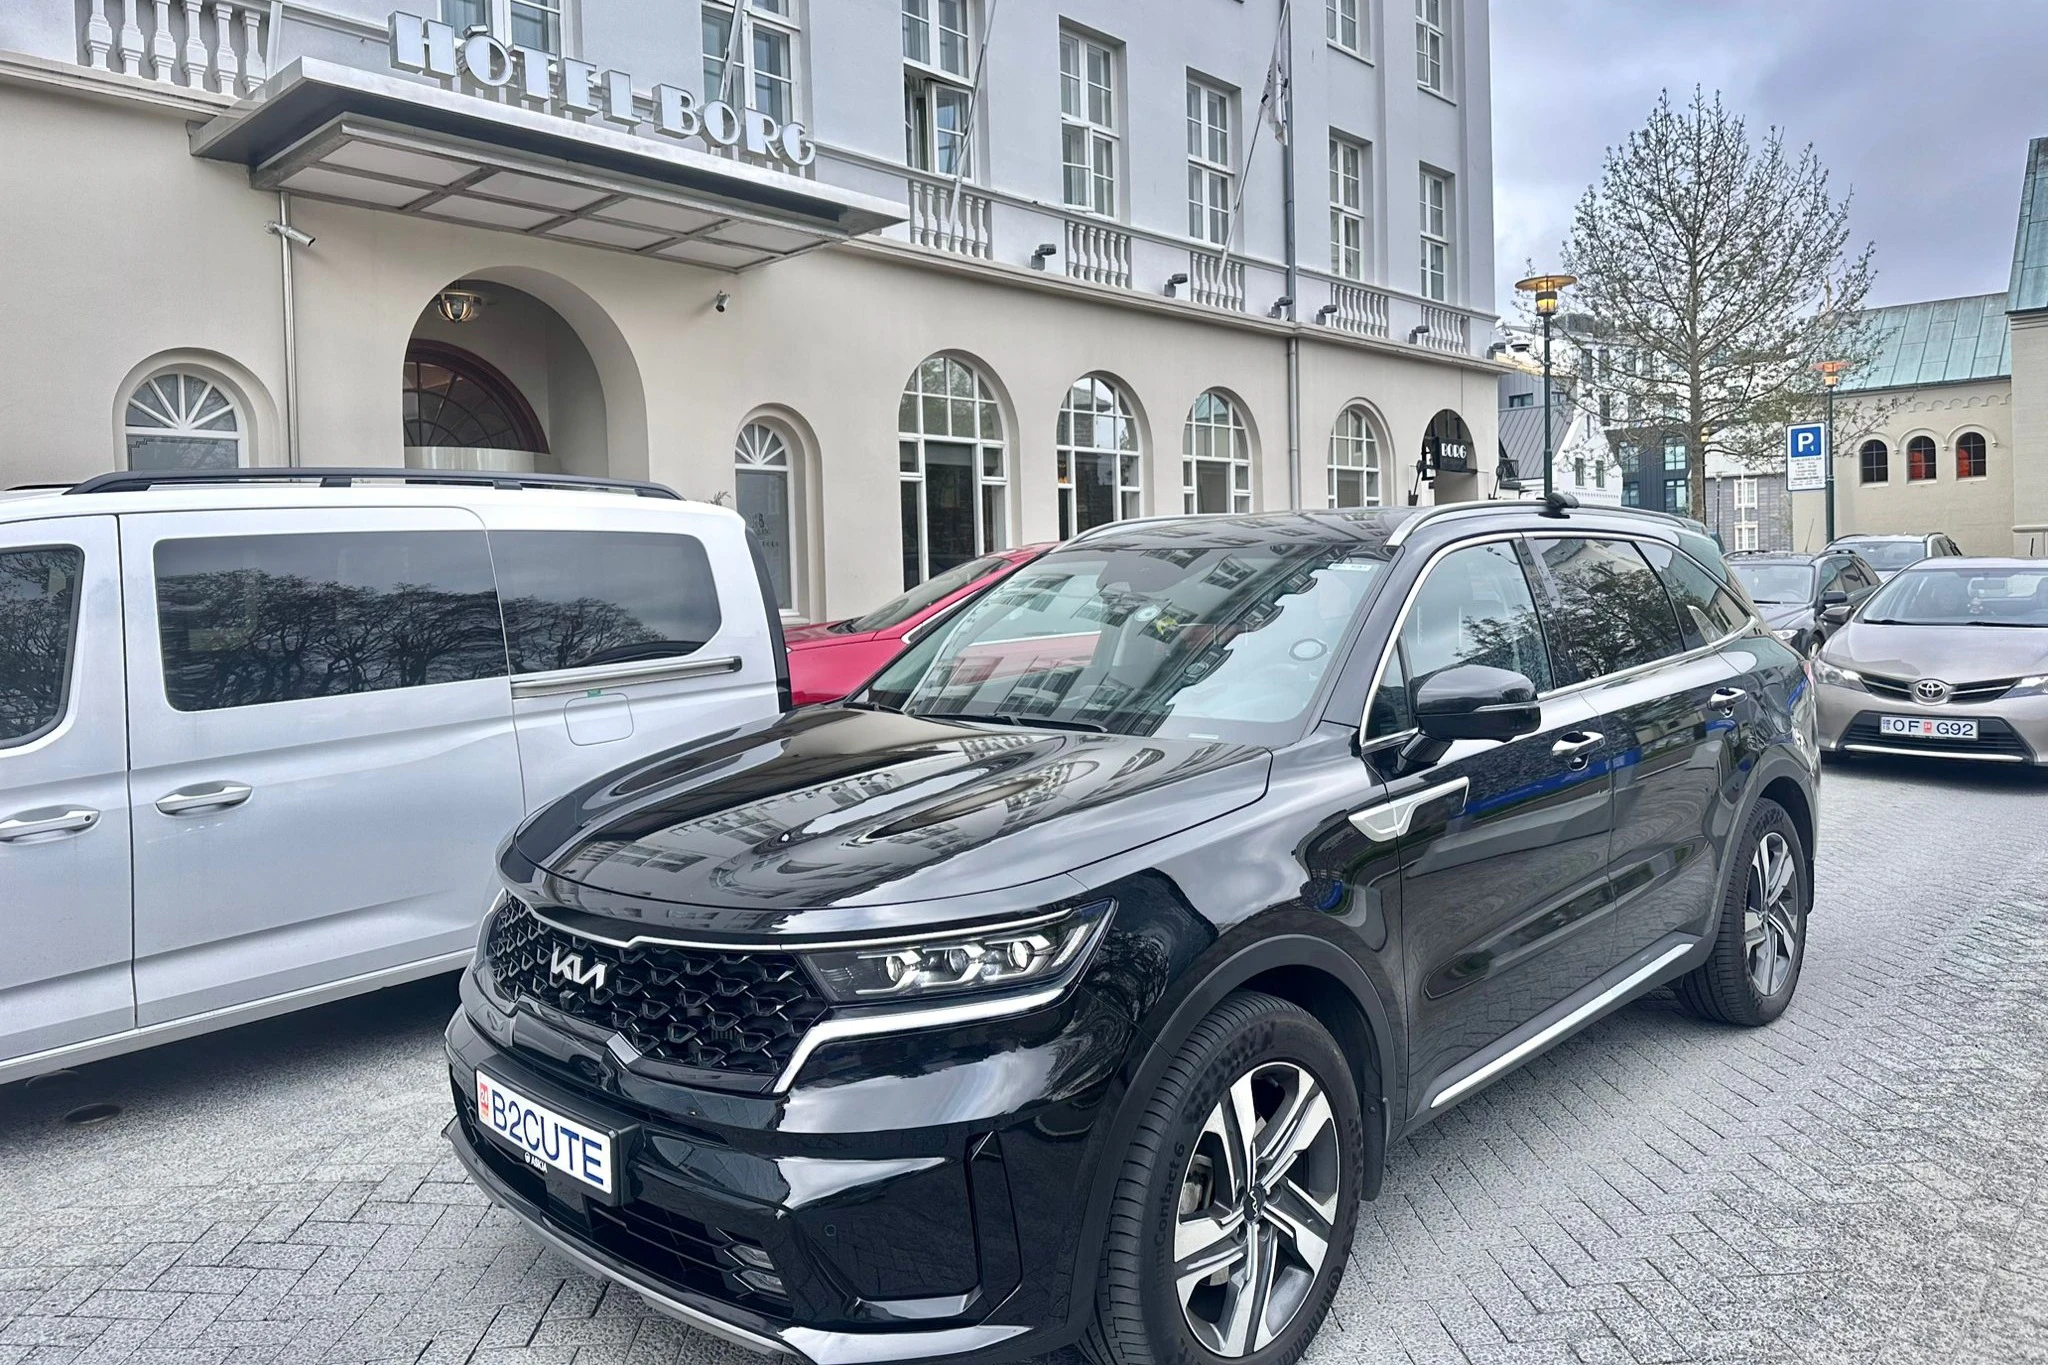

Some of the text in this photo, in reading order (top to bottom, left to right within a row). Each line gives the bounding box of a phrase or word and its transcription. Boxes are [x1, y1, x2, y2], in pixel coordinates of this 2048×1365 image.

[388, 10, 817, 167] HÓTEL BORG
[1442, 444, 1467, 459] BORG
[1937, 722, 1974, 736] G92
[551, 946, 607, 990] KIA
[492, 1089, 604, 1185] B2CUTE
